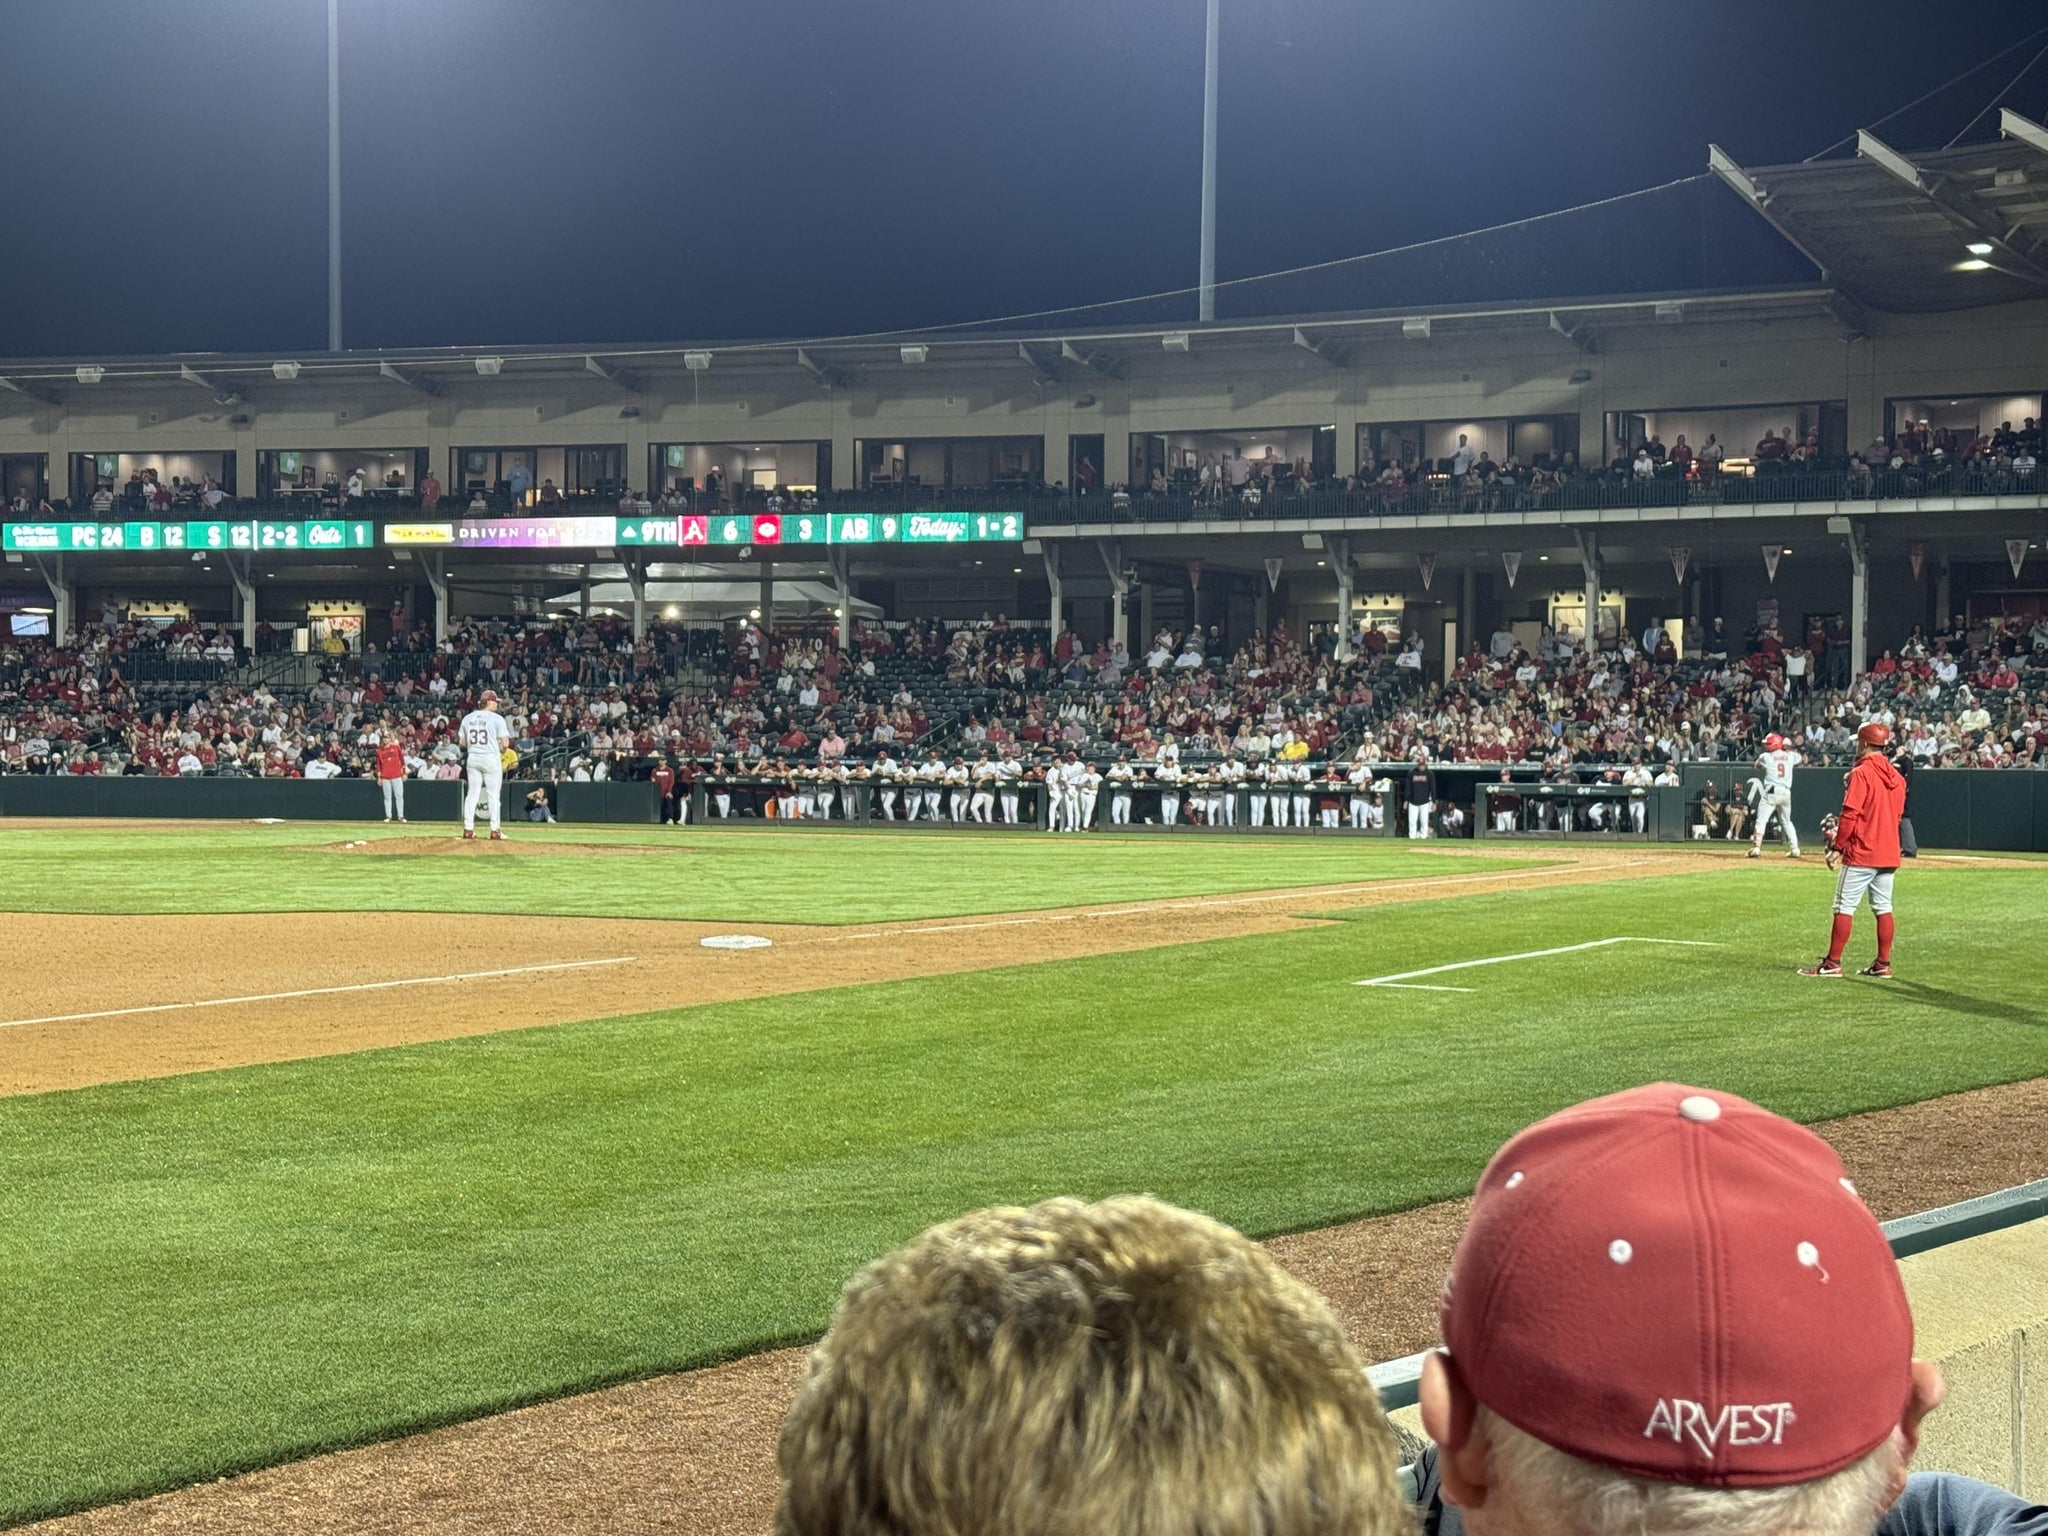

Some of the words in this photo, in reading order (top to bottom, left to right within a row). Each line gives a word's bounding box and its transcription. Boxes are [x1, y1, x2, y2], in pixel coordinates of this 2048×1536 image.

[71, 526, 96, 547] PC
[101, 527, 123, 547] 24
[140, 526, 154, 547] B
[164, 526, 183, 547] 12
[207, 526, 221, 547] S
[231, 526, 250, 547] 12
[354, 525, 364, 545] 1
[459, 527, 519, 539] DRIVEN
[527, 526, 557, 538] FOR
[642, 521, 675, 543] 9TH
[723, 520, 738, 541] 6
[799, 518, 813, 539] 3
[840, 518, 869, 538] AB
[882, 518, 897, 538] 9
[470, 729, 488, 745] 33
[1777, 763, 1785, 778] 9
